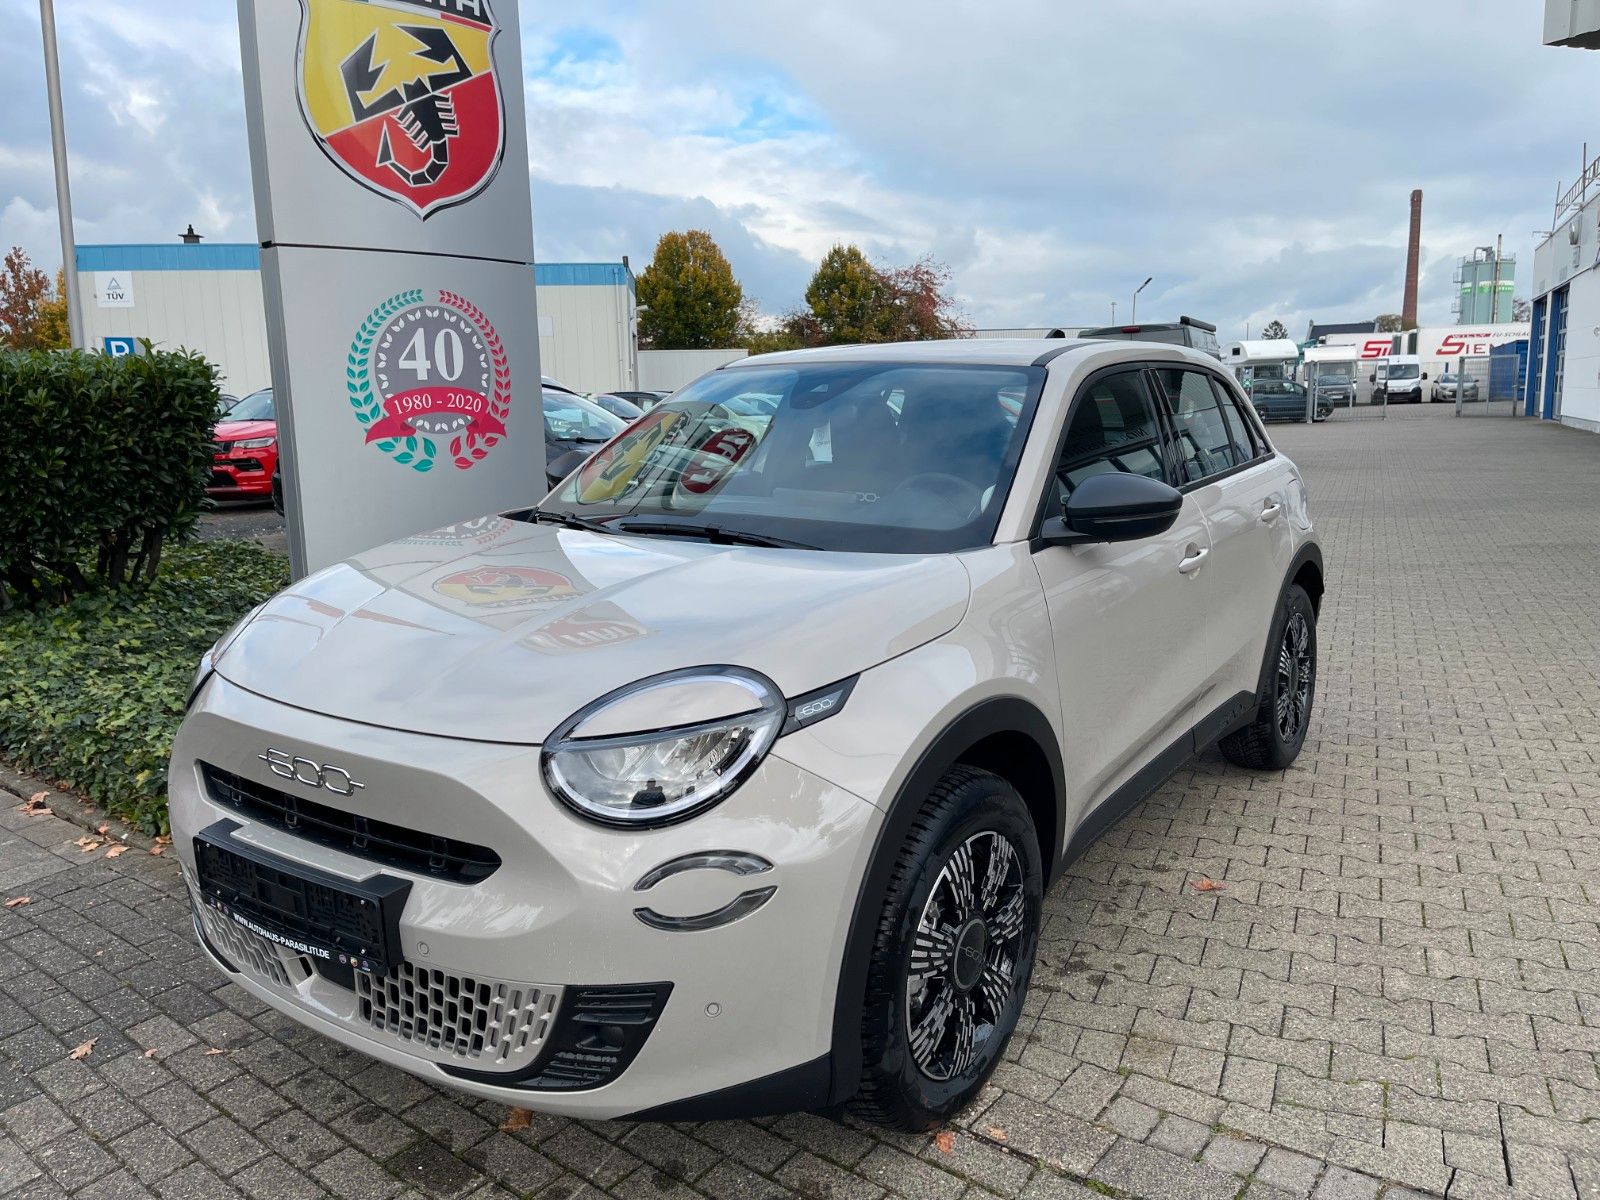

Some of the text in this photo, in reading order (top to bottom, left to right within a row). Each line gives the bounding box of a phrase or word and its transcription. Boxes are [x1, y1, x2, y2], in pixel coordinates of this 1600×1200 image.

[106, 291, 124, 300] TÜV
[398, 327, 464, 382] 40
[394, 393, 432, 415] 1980
[447, 392, 482, 413] 2020
[800, 698, 834, 716] 600
[257, 748, 365, 797] 600
